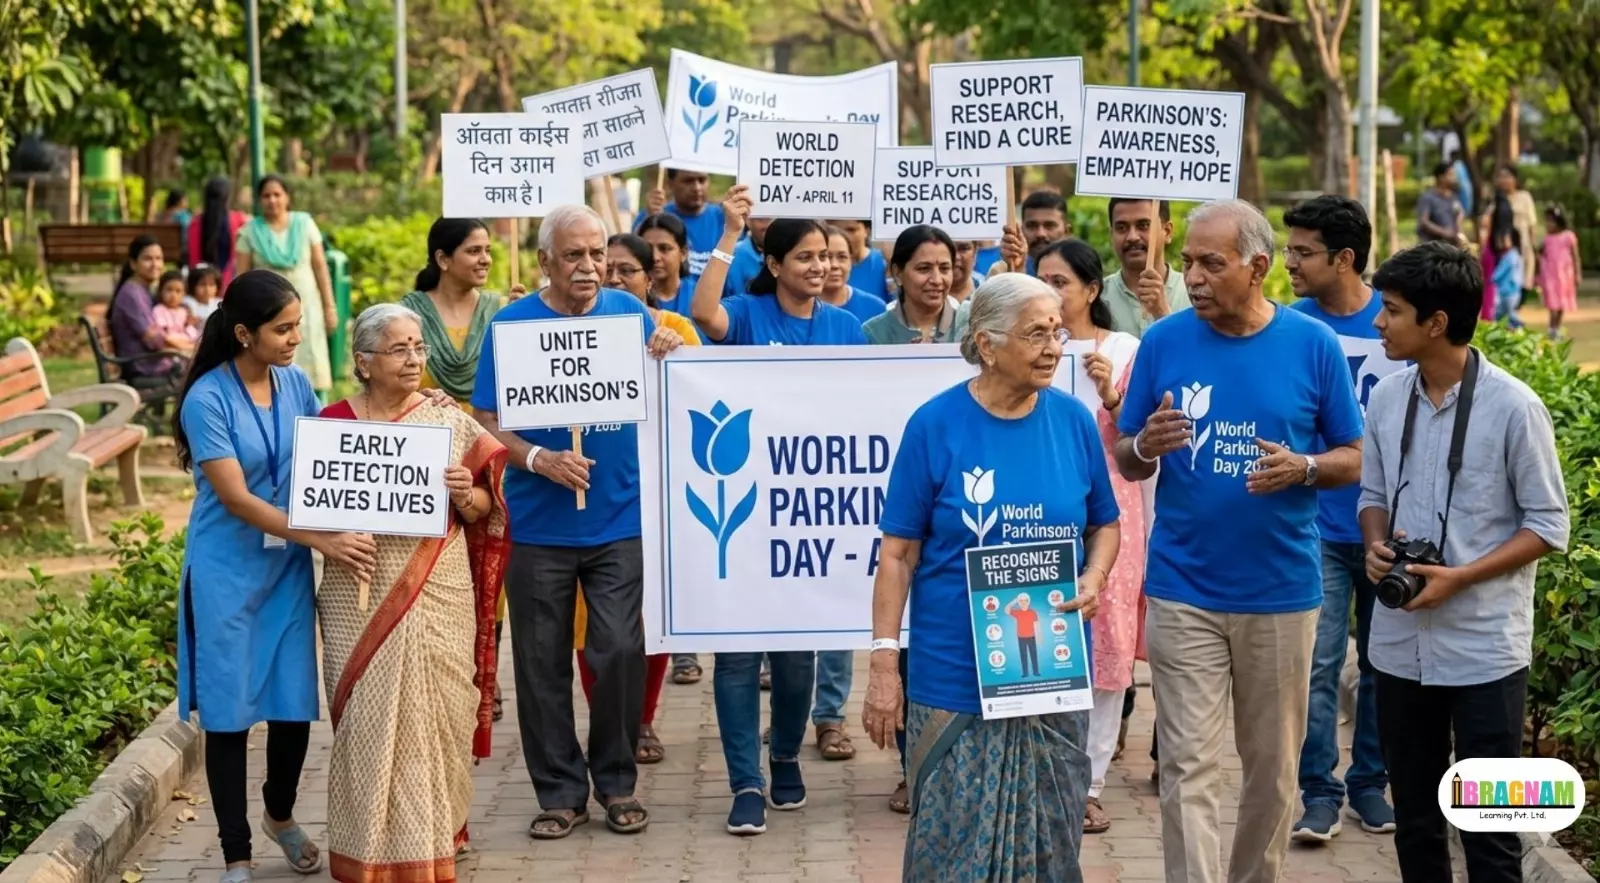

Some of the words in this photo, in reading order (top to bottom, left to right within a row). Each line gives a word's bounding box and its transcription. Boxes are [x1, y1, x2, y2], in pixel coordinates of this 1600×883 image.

[728, 86, 777, 108] World
[960, 74, 1054, 98] SUPPORT
[951, 100, 1065, 124] RESEARCH,
[1096, 101, 1228, 128] PARKINSON'S:
[776, 132, 838, 151] WORLD
[945, 129, 991, 150] FIND
[996, 128, 1012, 148] A
[1017, 126, 1072, 147] CURE
[1098, 130, 1221, 157] AWARENESS,
[470, 151, 503, 174] दिन
[759, 158, 855, 178] DETECTION
[1085, 156, 1175, 184] EMPATHY,
[1179, 161, 1232, 183] HOPE
[759, 184, 793, 203] DAY
[803, 190, 838, 204] APRIL
[841, 191, 854, 204] 11
[883, 184, 998, 203] RESEARCHS,
[883, 207, 925, 225] FIND
[930, 207, 943, 224] A
[948, 207, 998, 224] CURE
[539, 330, 599, 351] UNITE
[550, 356, 592, 377] FOR
[505, 380, 640, 406] PARKINSON'S
[1215, 421, 1257, 437] World
[339, 433, 408, 457] EARLY
[767, 434, 890, 475] WORLD
[312, 459, 430, 486] DETECTION
[1213, 458, 1241, 478] Day
[302, 487, 370, 511] SAVES
[377, 491, 436, 515] LIVES
[1001, 503, 1044, 520] World
[1002, 522, 1079, 539] Parkinson's
[769, 537, 836, 578] DAY
[981, 550, 1061, 571] RECOGNIZE
[985, 569, 1013, 586] THE
[1016, 565, 1060, 584] SIGNS
